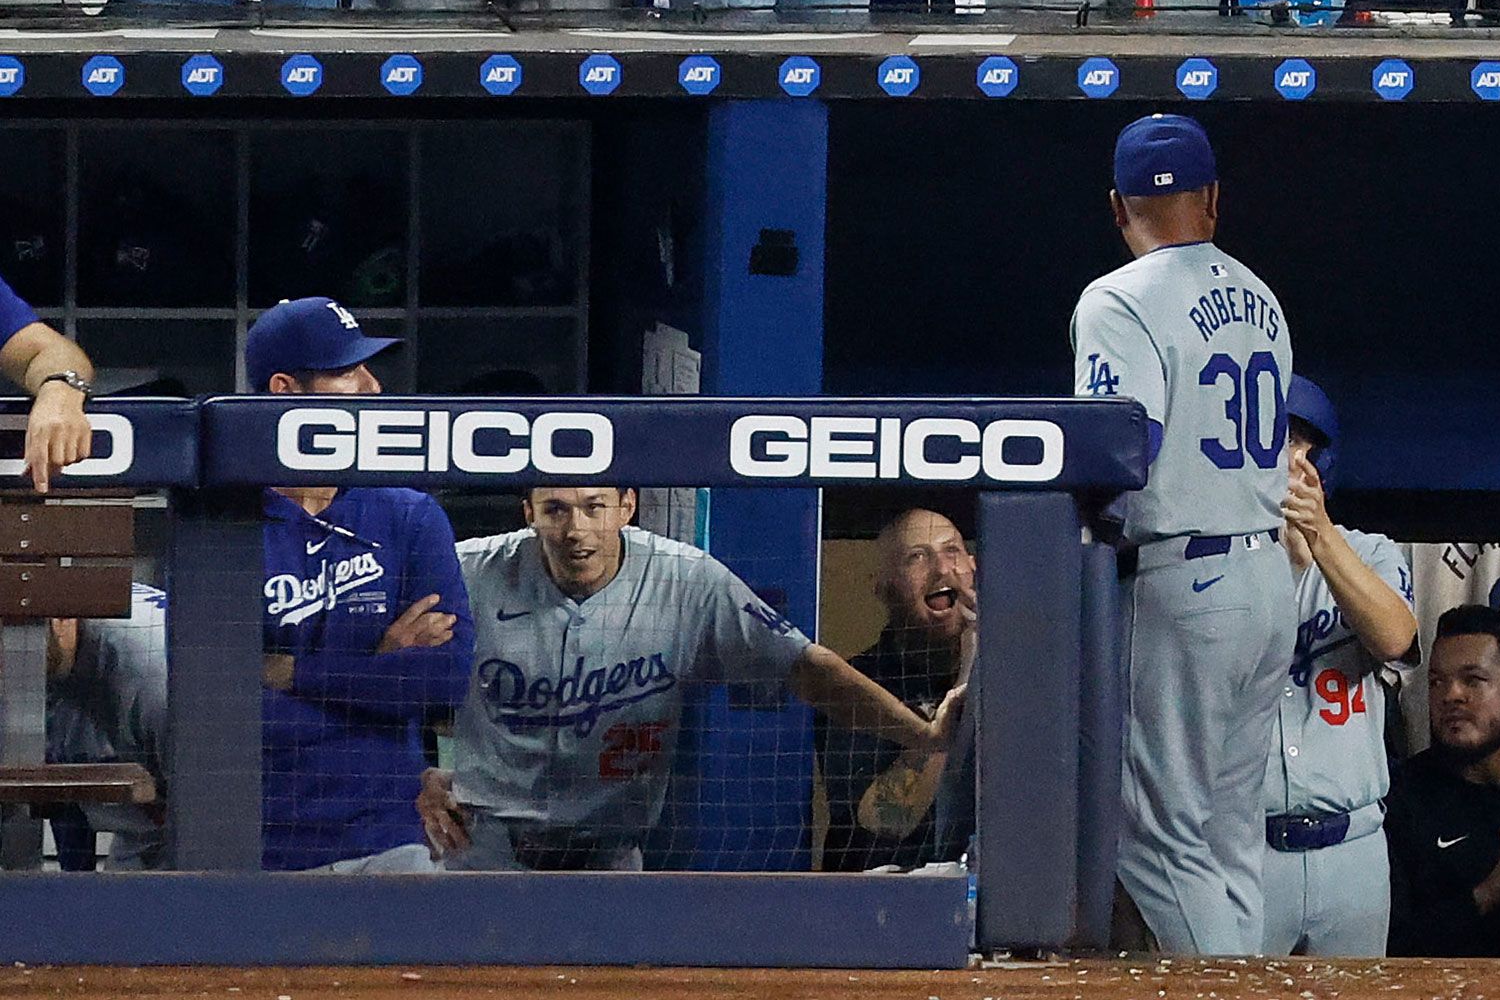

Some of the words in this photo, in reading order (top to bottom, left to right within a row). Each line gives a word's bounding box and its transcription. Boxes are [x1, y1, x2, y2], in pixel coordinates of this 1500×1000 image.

[87, 67, 119, 84] ADT
[187, 67, 219, 83] ADT
[286, 67, 318, 83] ADT
[386, 67, 418, 83] ADT
[485, 67, 517, 83] ADT
[585, 66, 616, 82] ADT
[683, 66, 715, 82] ADT
[784, 68, 815, 84] ADT
[883, 68, 914, 84] ADT
[982, 68, 1013, 84] ADT
[1083, 70, 1115, 86] ADT
[1182, 70, 1213, 86] ADT
[1280, 71, 1311, 87] ADT
[1378, 71, 1409, 88] ADT
[326, 302, 360, 330] LA
[1189, 286, 1280, 343] ROBERTS
[1086, 353, 1120, 395] LA
[1198, 350, 1289, 470] 30
[277, 408, 614, 475] GEICO
[730, 414, 1064, 482] GEICO
[478, 652, 676, 739] Dodgers
